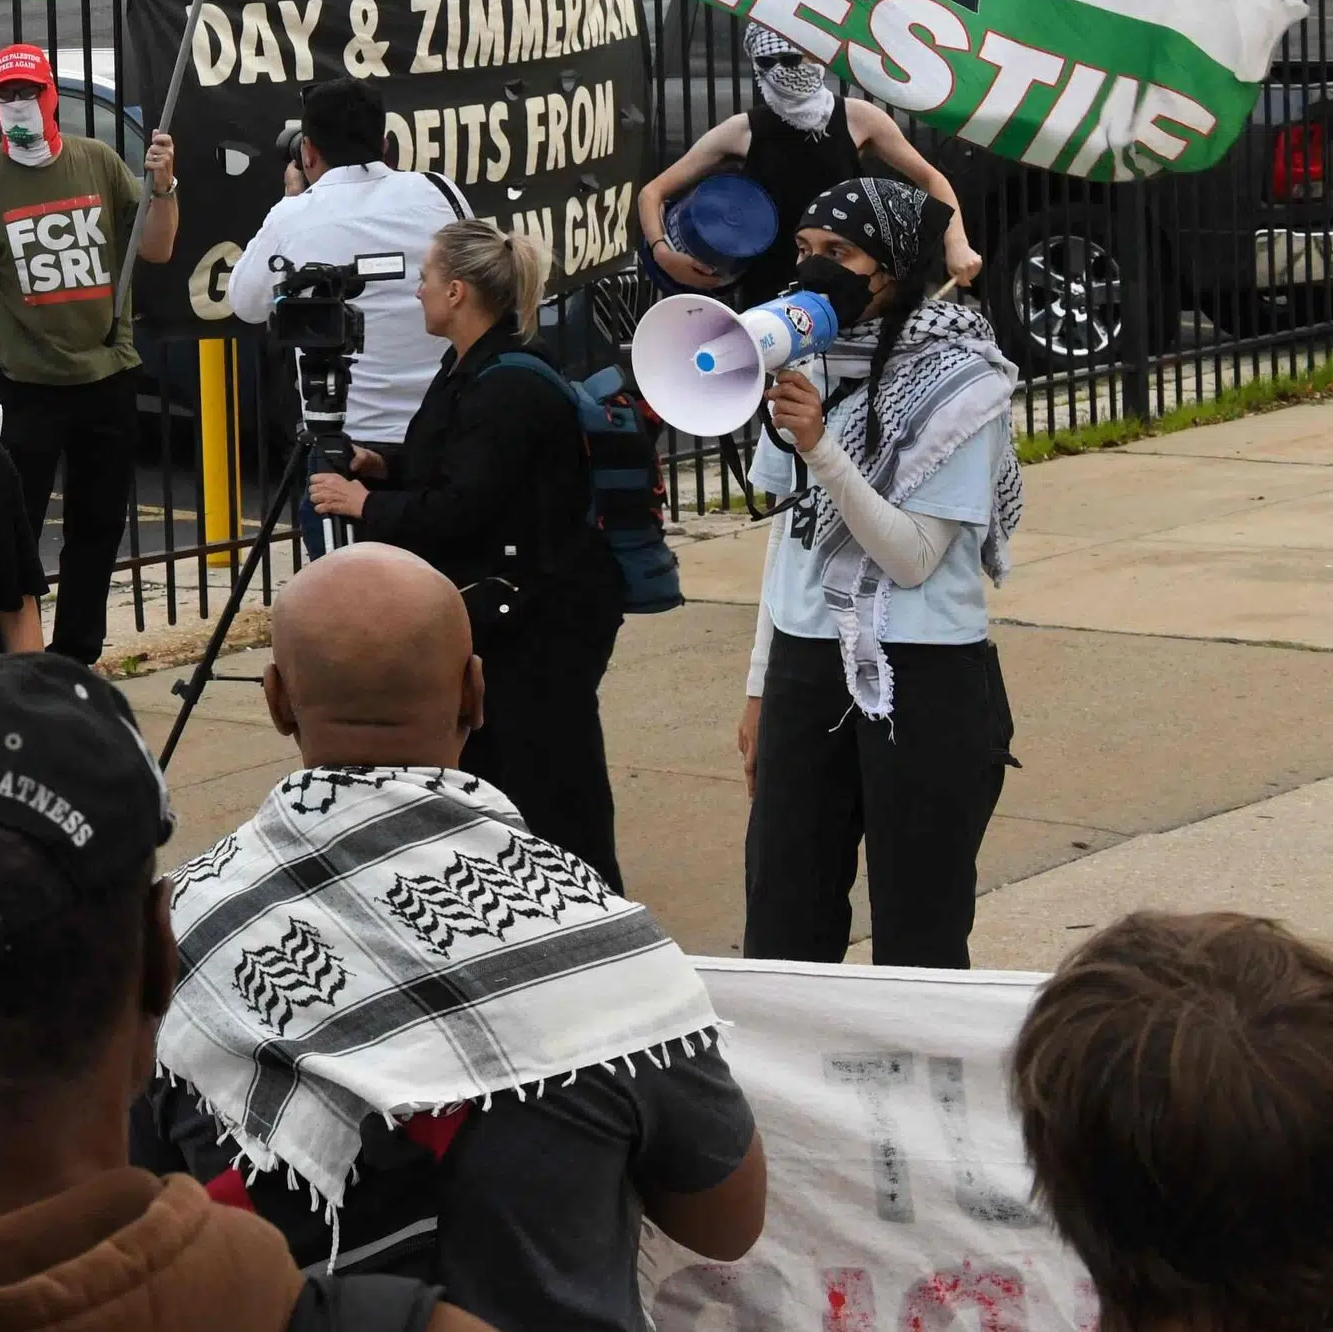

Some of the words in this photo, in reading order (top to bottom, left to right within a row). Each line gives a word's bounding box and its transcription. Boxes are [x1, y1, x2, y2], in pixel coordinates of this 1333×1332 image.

[381, 100, 512, 186] OFITS
[524, 79, 615, 176] FROM
[5, 206, 108, 260] FCK
[564, 181, 633, 277] GAZA
[13, 245, 112, 295] ISRL
